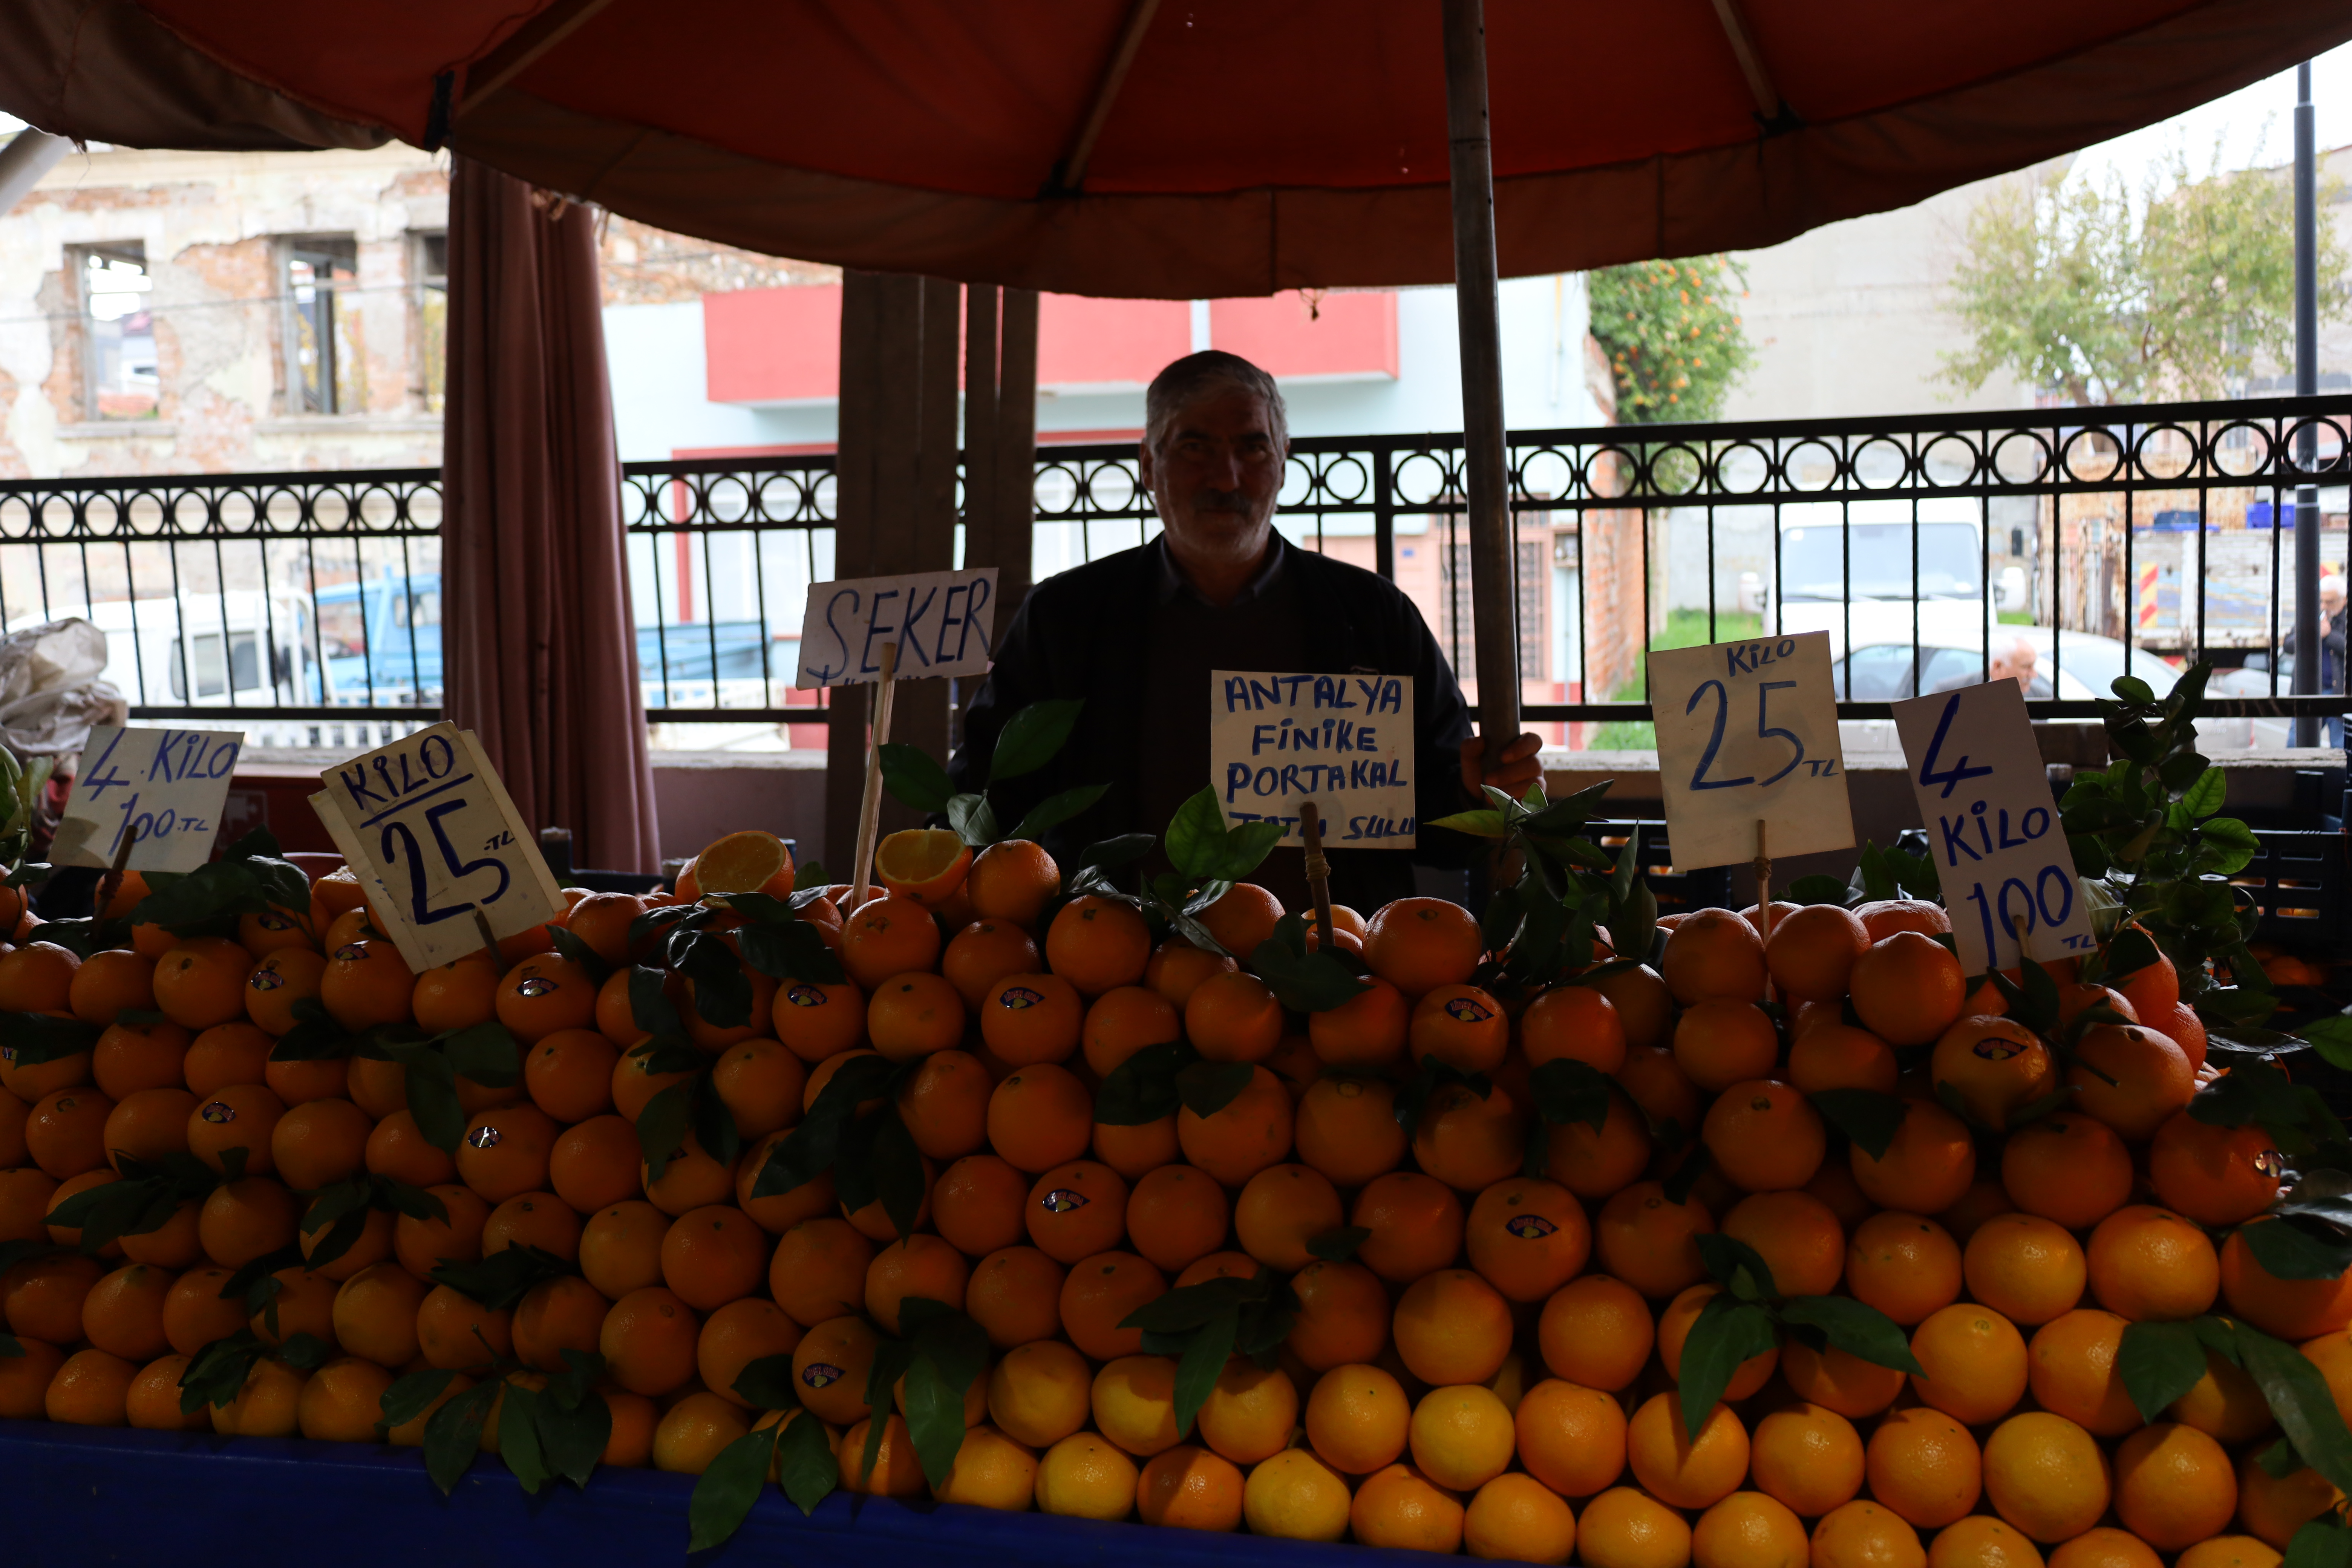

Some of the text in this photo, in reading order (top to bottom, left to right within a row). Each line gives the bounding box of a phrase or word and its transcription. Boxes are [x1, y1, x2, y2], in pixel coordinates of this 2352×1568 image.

[806, 577, 991, 685] ŞEKER
[1225, 675, 1401, 715] ANTALYA
[1686, 680, 1839, 791] 25 TL
[1919, 694, 1993, 798] 4
[1226, 759, 1407, 803] PORTAKAL
[1341, 815, 1415, 840] SULU
[381, 798, 510, 925] 25
[1966, 865, 2073, 968] 100
[2061, 934, 2097, 949] TL
